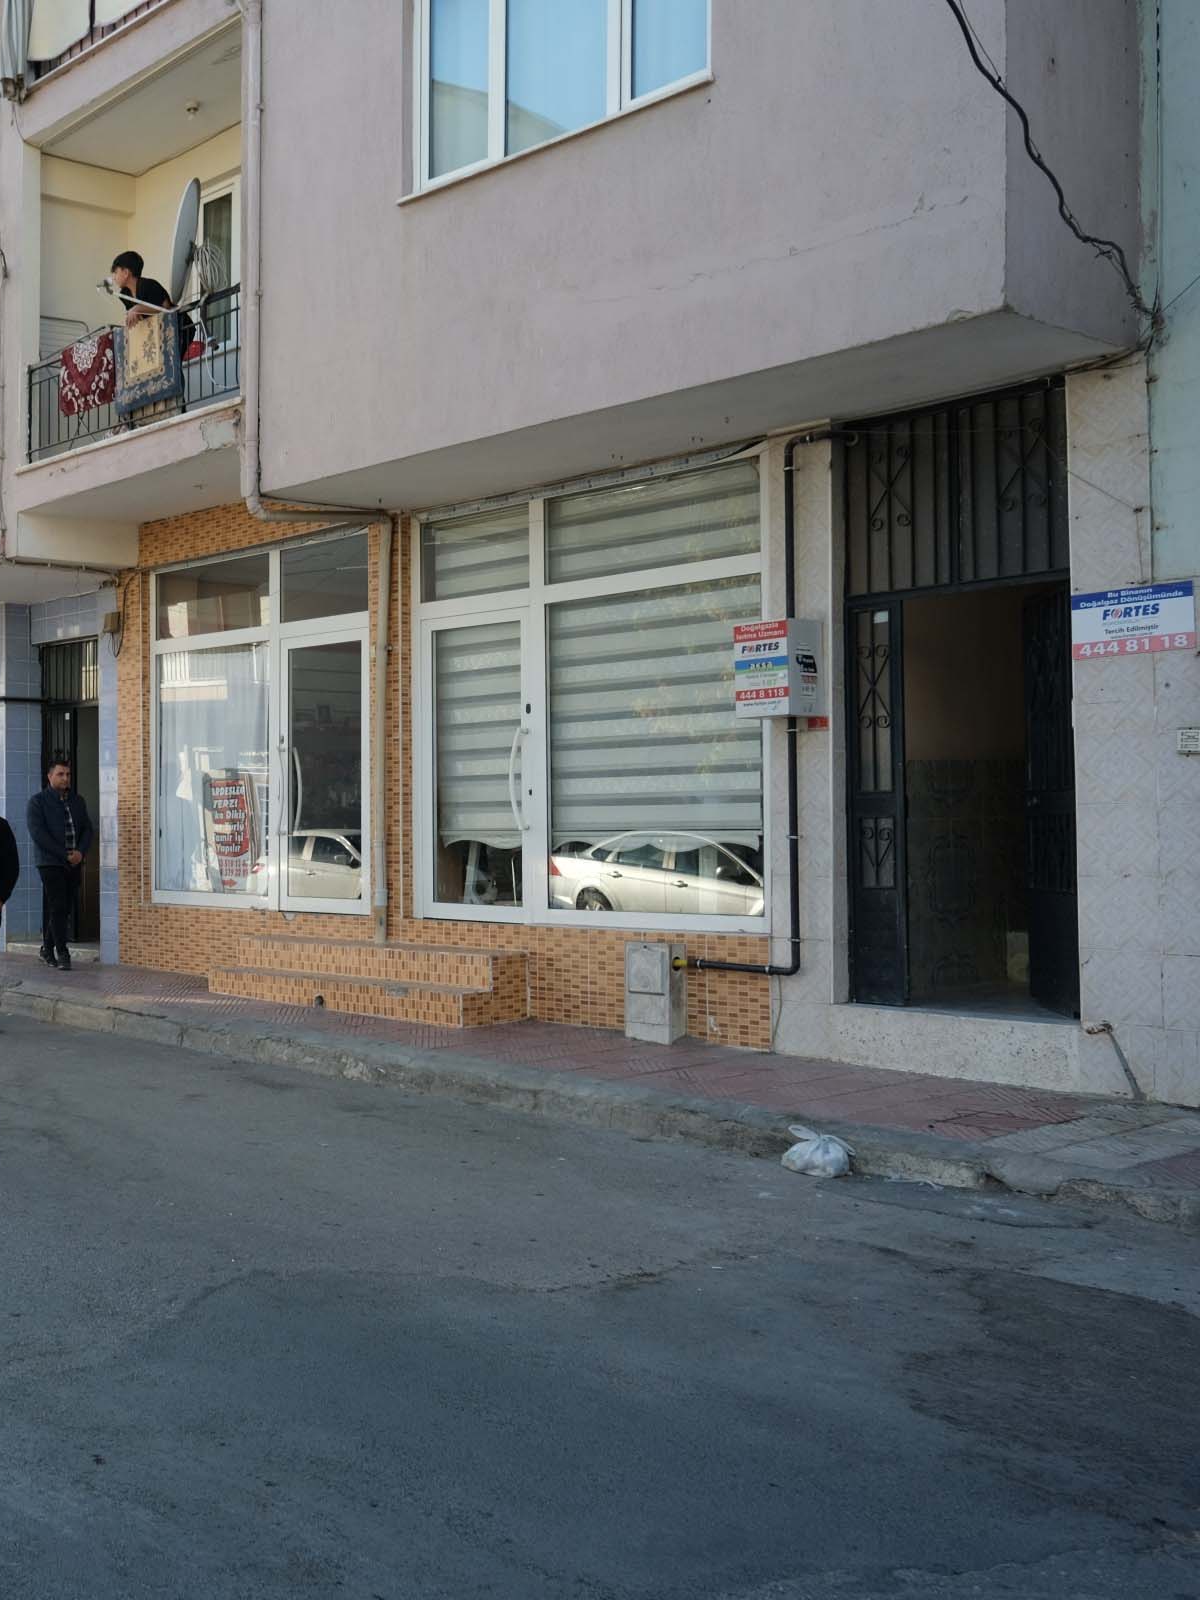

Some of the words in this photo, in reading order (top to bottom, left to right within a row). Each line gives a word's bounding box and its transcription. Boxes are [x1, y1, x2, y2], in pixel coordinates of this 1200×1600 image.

[1102, 603, 1160, 620] FORTES
[741, 641, 780, 654] FORTES
[1080, 641, 1120, 657] 444
[1125, 638, 1150, 652] 81
[1160, 634, 1188, 649] 18
[740, 691, 756, 700] 444
[759, 690, 765, 698] 8
[767, 688, 785, 697] 118
